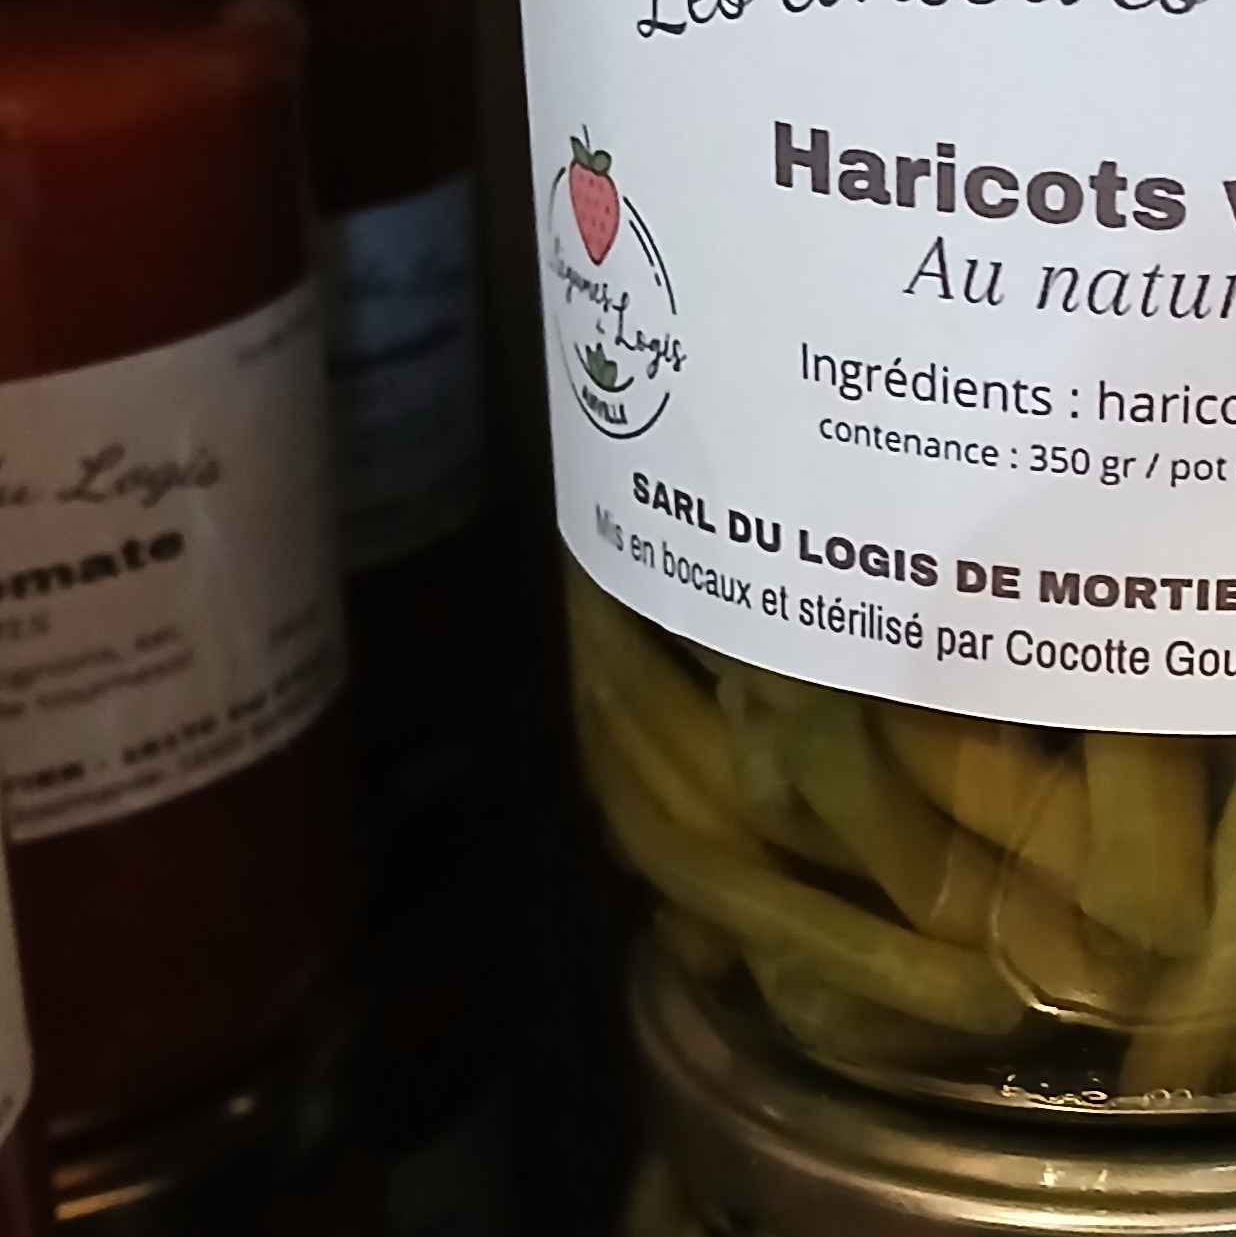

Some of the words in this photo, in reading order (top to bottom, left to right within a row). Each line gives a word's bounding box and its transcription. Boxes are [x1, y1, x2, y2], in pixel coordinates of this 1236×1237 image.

[773, 120, 1188, 232] Haricots
[902, 235, 1006, 307] Au
[801, 341, 1053, 416] Ingrédients
[1070, 388, 1079, 419] :
[818, 417, 1000, 468] contenance
[1010, 447, 1018, 470] :
[1029, 443, 1091, 476] 350
[1099, 455, 1138, 486] gr
[1144, 452, 1160, 480] /
[1170, 456, 1228, 489] pot
[632, 471, 717, 535] SARL
[727, 508, 782, 553] DU
[798, 528, 939, 588] LOGIS
[955, 559, 1022, 600] DE
[629, 533, 656, 570] en
[661, 540, 753, 610] bocaux
[761, 585, 790, 622] et
[798, 594, 924, 650] stérilisé
[936, 626, 995, 662] par
[1005, 629, 1151, 676] Cocotte
